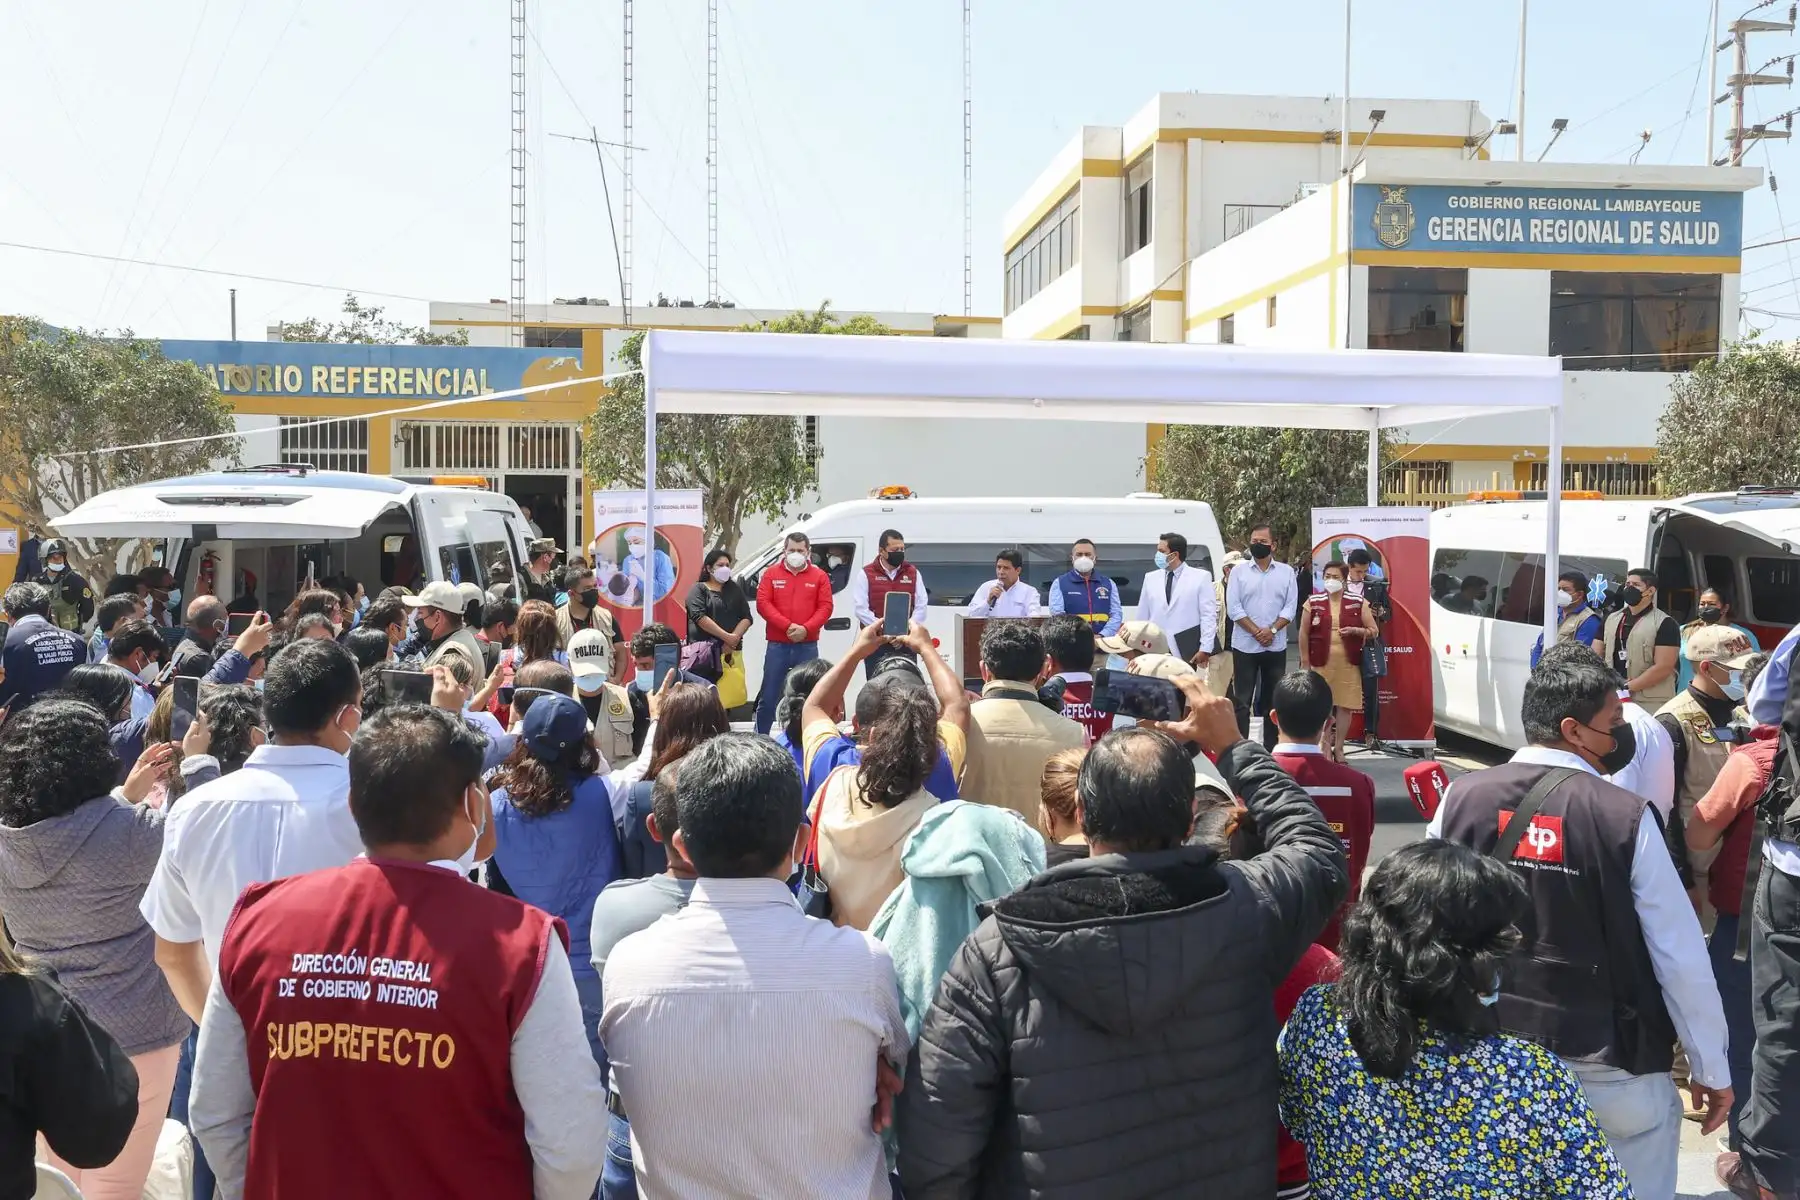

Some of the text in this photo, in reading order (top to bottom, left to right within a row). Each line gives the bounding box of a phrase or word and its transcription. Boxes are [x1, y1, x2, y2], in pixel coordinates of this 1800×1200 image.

[1448, 196, 1701, 213] GOBIERNO REGIONAL LAMBAYEQUE
[1428, 216, 1720, 245] GERENCIA REGIONAL DE SALUD
[205, 363, 495, 396] ATORIO REFERENCIAL
[39, 656, 73, 665] LAMBAYEQUE
[574, 644, 604, 659] POLICIA
[1061, 703, 1106, 719] REFECO
[1526, 822, 1557, 855] tp
[291, 949, 432, 983] DIRECCIÓN GENERAL
[279, 978, 439, 1009] DE GOBIERNO INTERIOR
[266, 1020, 456, 1069] SUBPREFECTO
